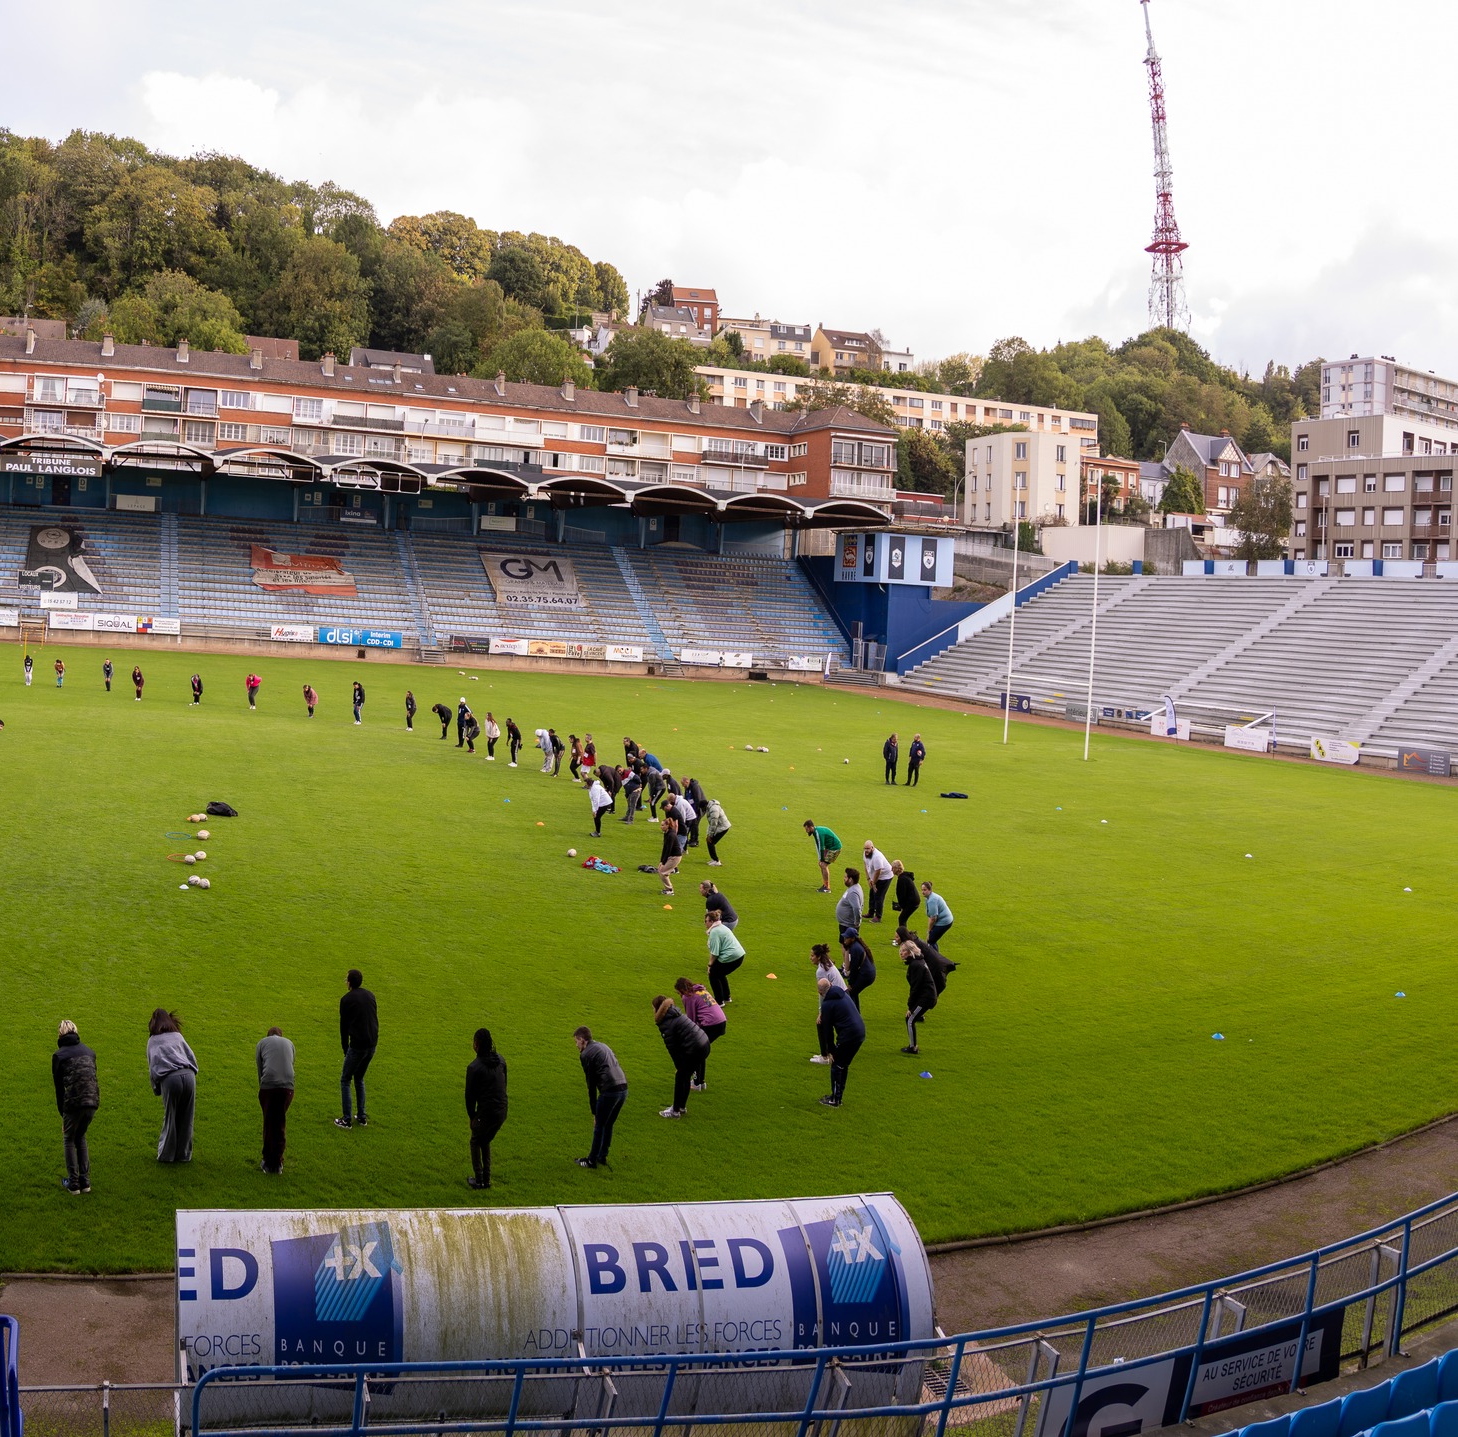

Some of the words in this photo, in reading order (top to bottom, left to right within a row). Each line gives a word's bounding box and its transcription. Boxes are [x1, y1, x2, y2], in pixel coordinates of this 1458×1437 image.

[5, 463, 33, 472] PAUL
[38, 464, 96, 476] LANGLOIS
[31, 457, 72, 466] TRIBUNE
[506, 594, 579, 605] 02.35.75.64.07
[326, 628, 353, 644] dlsi
[582, 1237, 775, 1295] BRED
[523, 1325, 670, 1350] ADDITIONNER
[676, 1322, 708, 1345] LES
[713, 1319, 782, 1343] FORCES
[798, 1321, 896, 1338] BANQUE
[184, 1333, 261, 1357] FORCES
[280, 1338, 386, 1357] BANQUE
[1202, 1367, 1218, 1383] AU
[1220, 1356, 1265, 1379] SERVICE
[1266, 1351, 1282, 1364] DE
[1282, 1336, 1316, 1359] VORE
[1232, 1364, 1283, 1392] SÉCURITÉ
